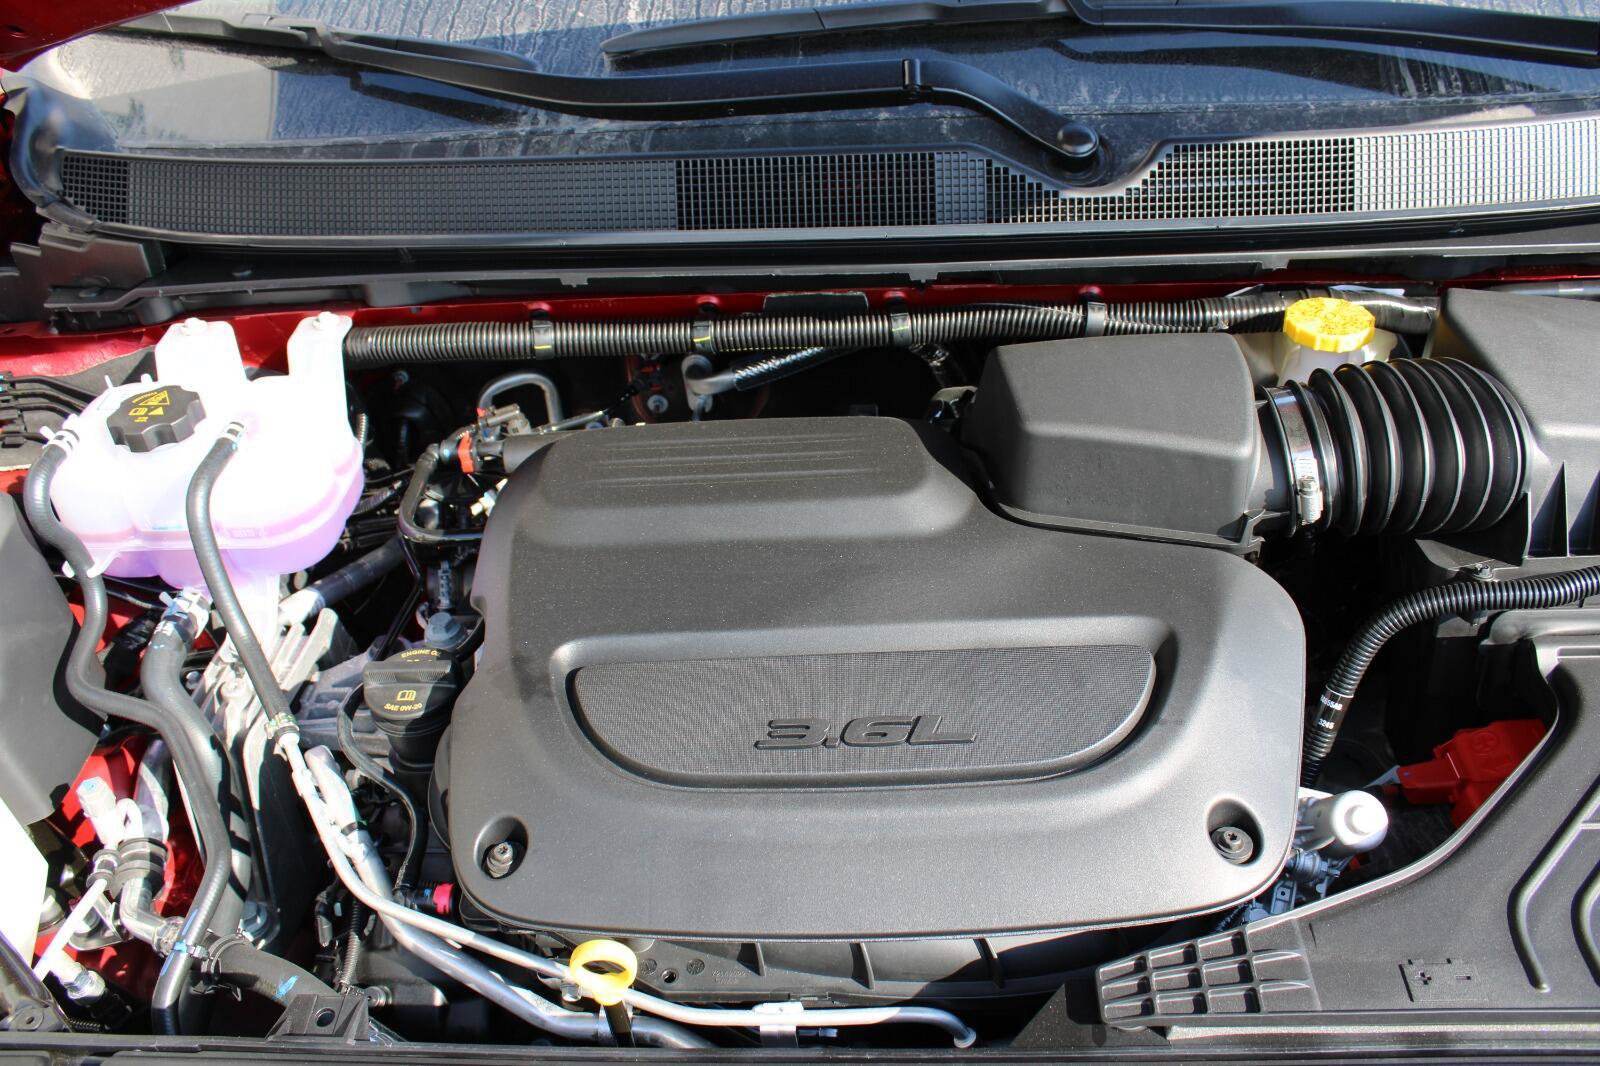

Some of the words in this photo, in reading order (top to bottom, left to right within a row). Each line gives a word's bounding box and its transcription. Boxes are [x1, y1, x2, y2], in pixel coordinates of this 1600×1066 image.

[401, 649, 431, 658] ENGINE
[384, 703, 399, 711] SAE
[753, 715, 977, 750] 3.6L
